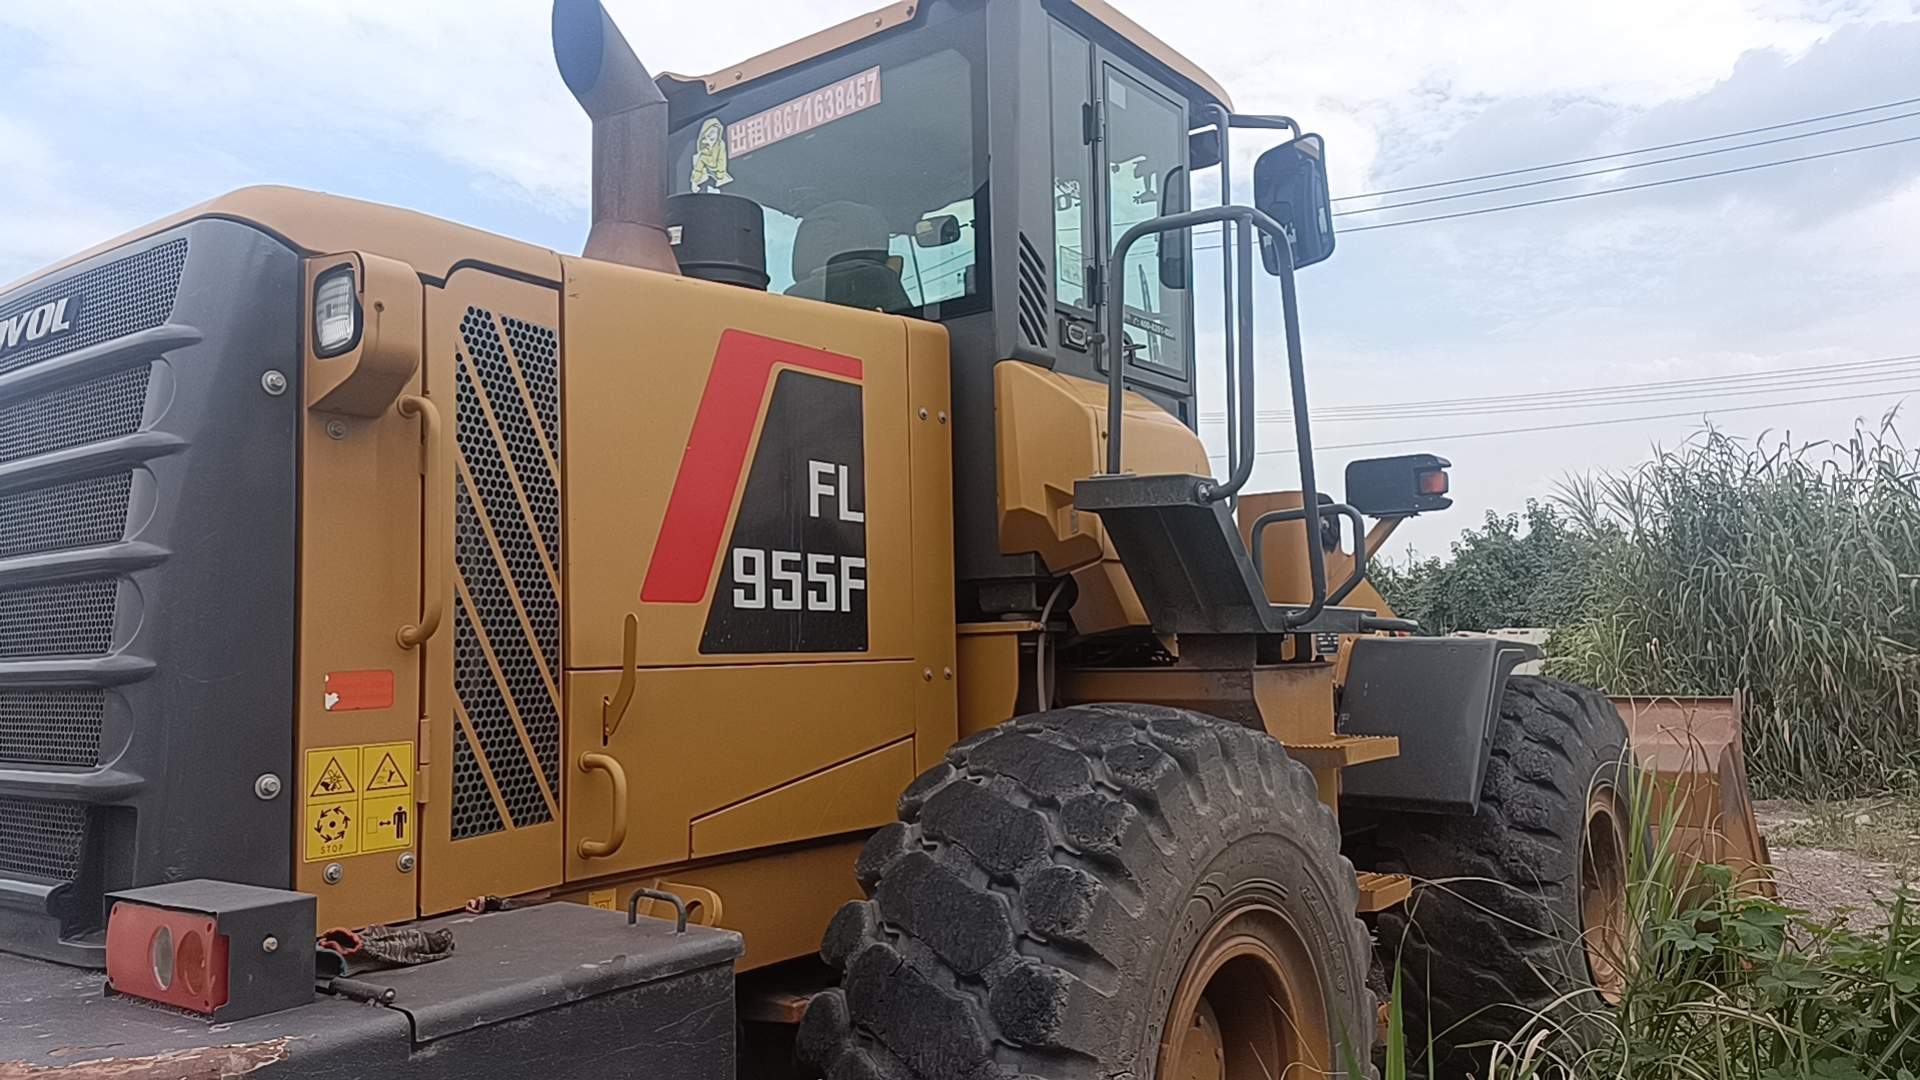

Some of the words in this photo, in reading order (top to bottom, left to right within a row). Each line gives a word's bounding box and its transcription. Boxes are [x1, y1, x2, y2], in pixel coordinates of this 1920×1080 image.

[808, 459, 865, 523] FL
[732, 547, 866, 613] 955F
[319, 843, 344, 855] STOP
